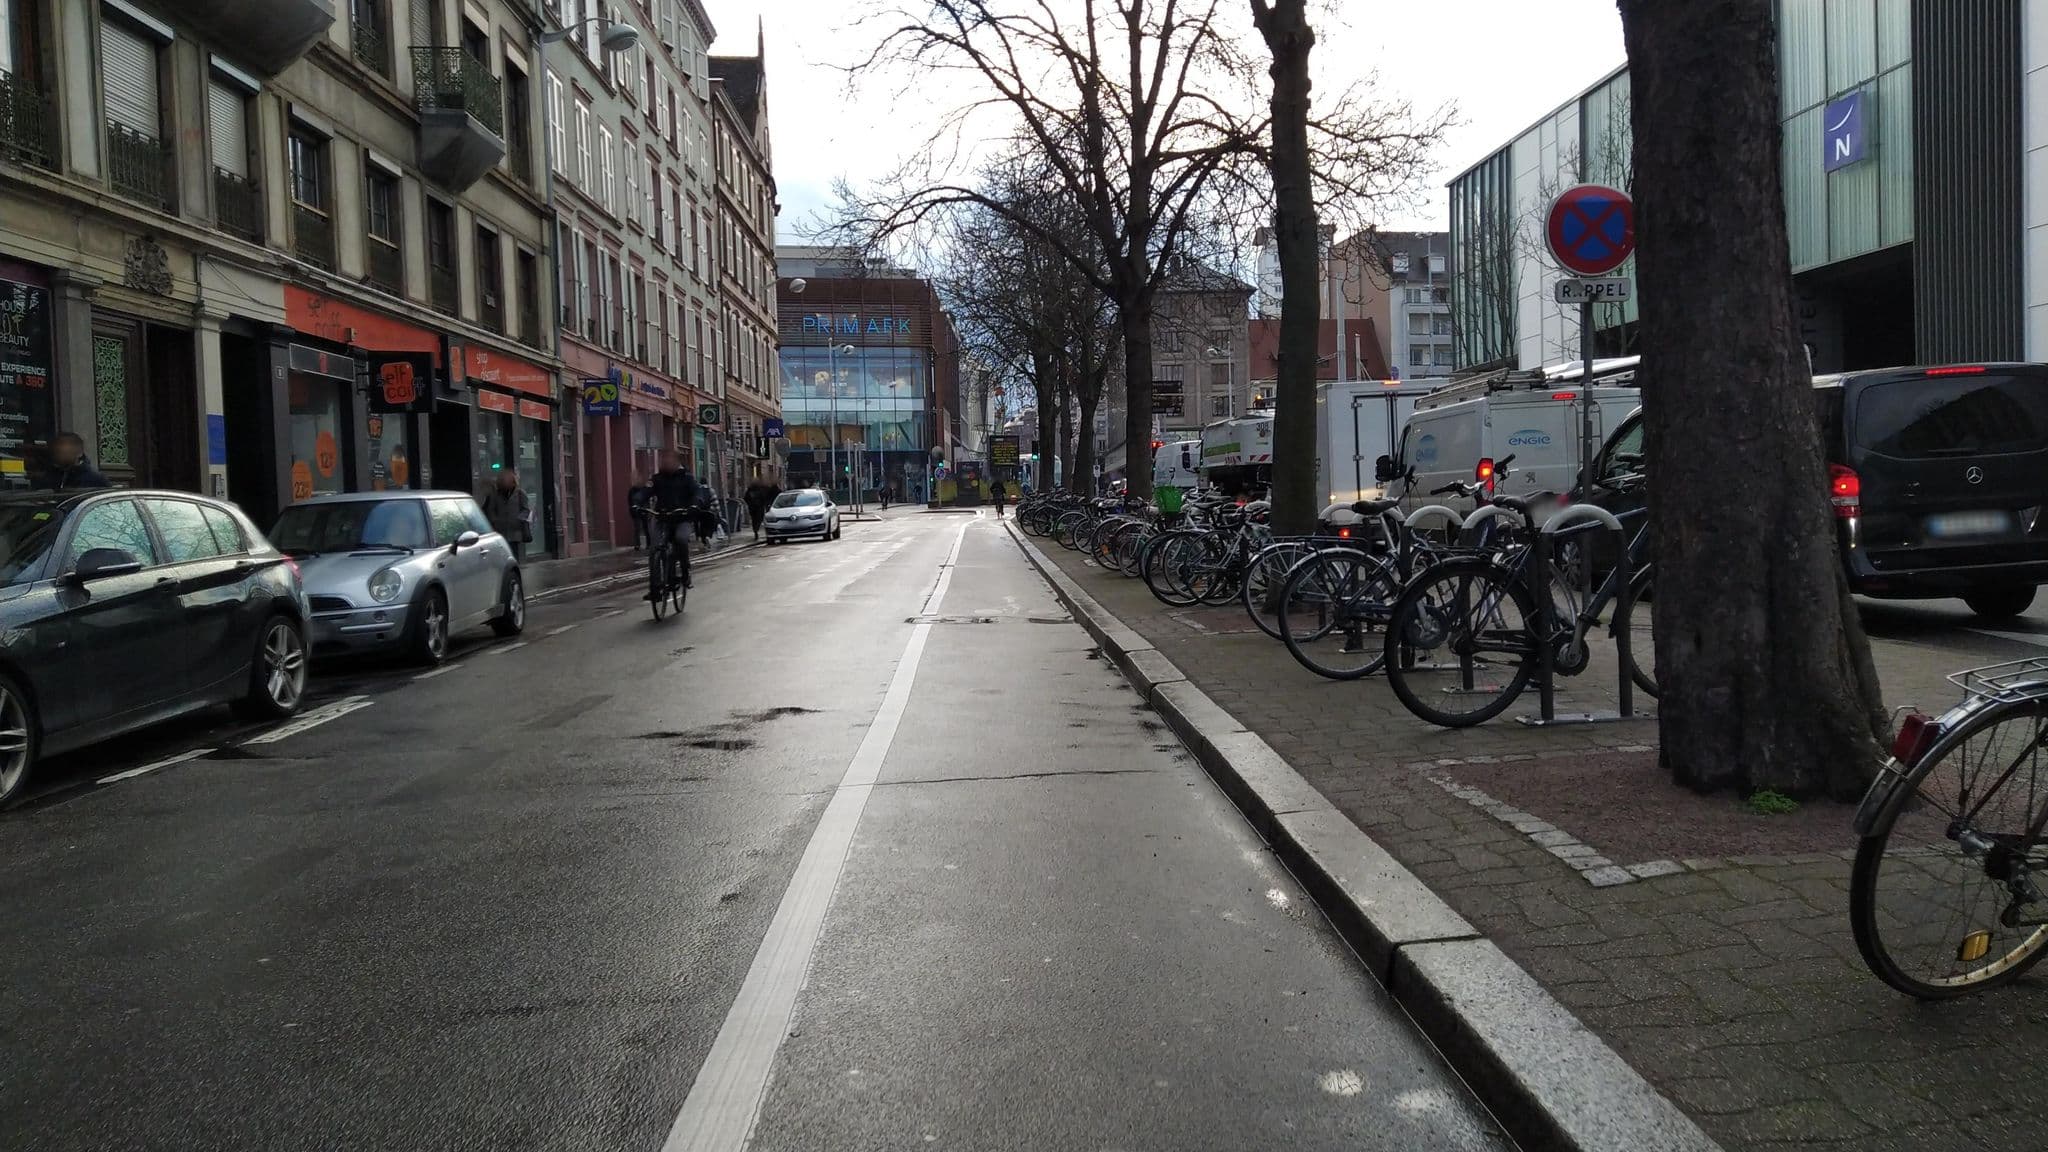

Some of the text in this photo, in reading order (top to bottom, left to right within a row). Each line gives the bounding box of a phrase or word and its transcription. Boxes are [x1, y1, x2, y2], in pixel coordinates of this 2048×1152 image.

[1835, 132, 1851, 161] N
[1562, 283, 1626, 298] RPPEL
[803, 316, 912, 335] PRIMARK
[1, 362, 47, 376] EXPERIENCE
[0, 374, 15, 384] UTE
